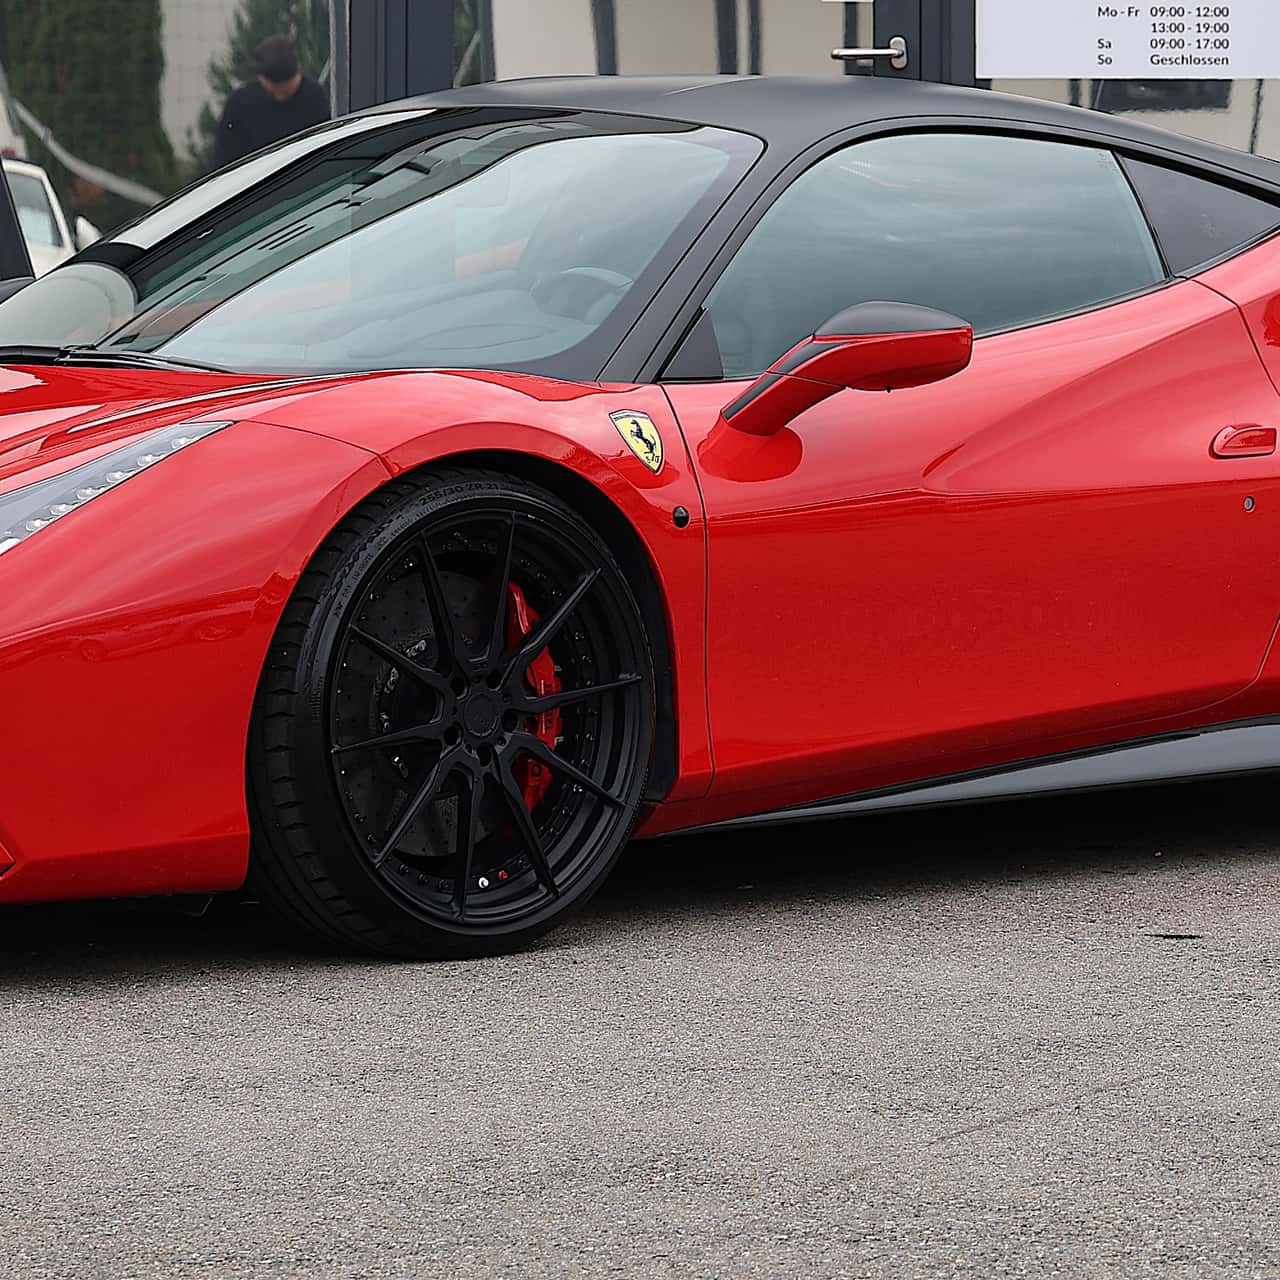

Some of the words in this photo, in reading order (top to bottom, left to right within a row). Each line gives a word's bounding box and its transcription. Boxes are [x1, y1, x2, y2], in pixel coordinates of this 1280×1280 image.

[1097, 6, 1118, 18] Mo
[1127, 6, 1141, 18] Fr
[1150, 6, 1185, 18] 09:00
[1195, 6, 1230, 18] 12:00
[1151, 22, 1185, 34] 13:00
[1195, 22, 1230, 34] 19:00
[1097, 38, 1112, 50] Sa
[1150, 38, 1185, 50] 09:00
[1195, 38, 1230, 50] 17:00
[1097, 54, 1113, 66] So
[1150, 54, 1230, 66] Geschlossen
